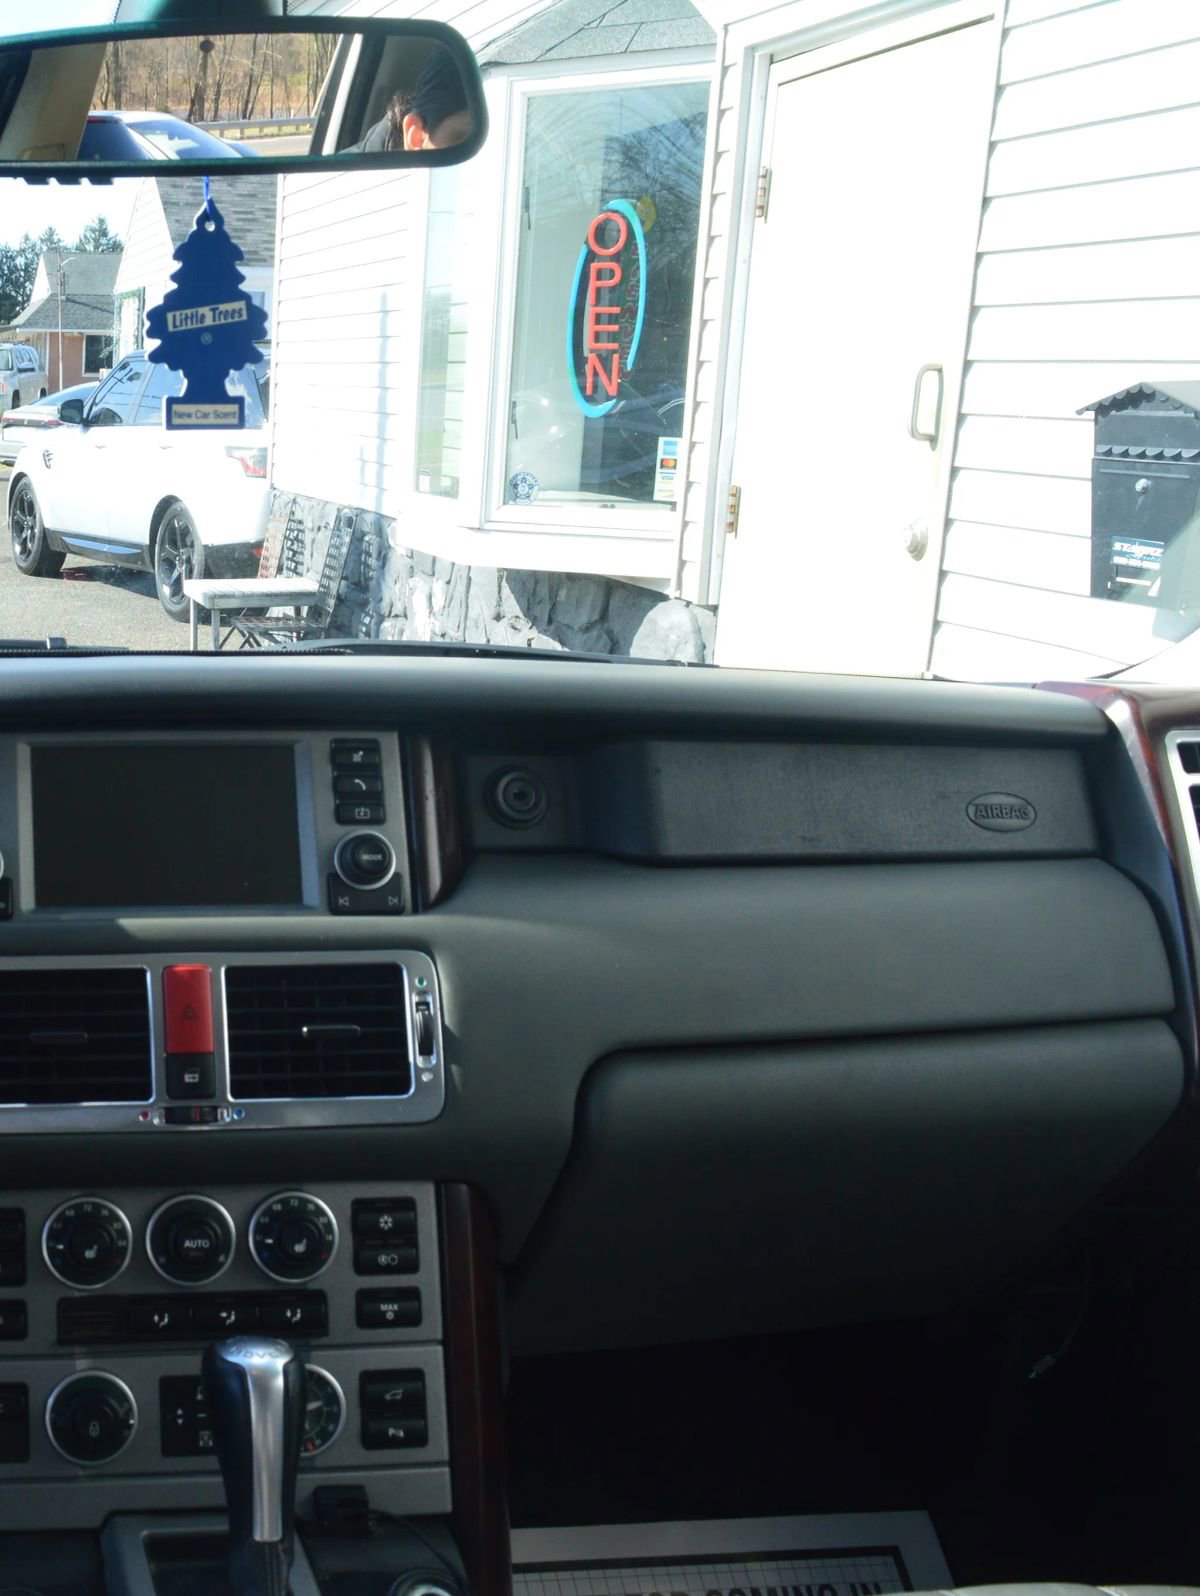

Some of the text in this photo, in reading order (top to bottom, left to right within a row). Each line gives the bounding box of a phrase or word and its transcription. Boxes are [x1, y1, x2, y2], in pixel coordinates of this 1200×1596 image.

[585, 211, 628, 396] OPEN
[172, 306, 244, 329] Little Trees
[174, 409, 238, 419] New Car Scent
[975, 804, 1031, 819] AIRBAG
[362, 853, 383, 861] MODE
[183, 1239, 210, 1248] AUTO
[380, 1303, 399, 1312] MAX
